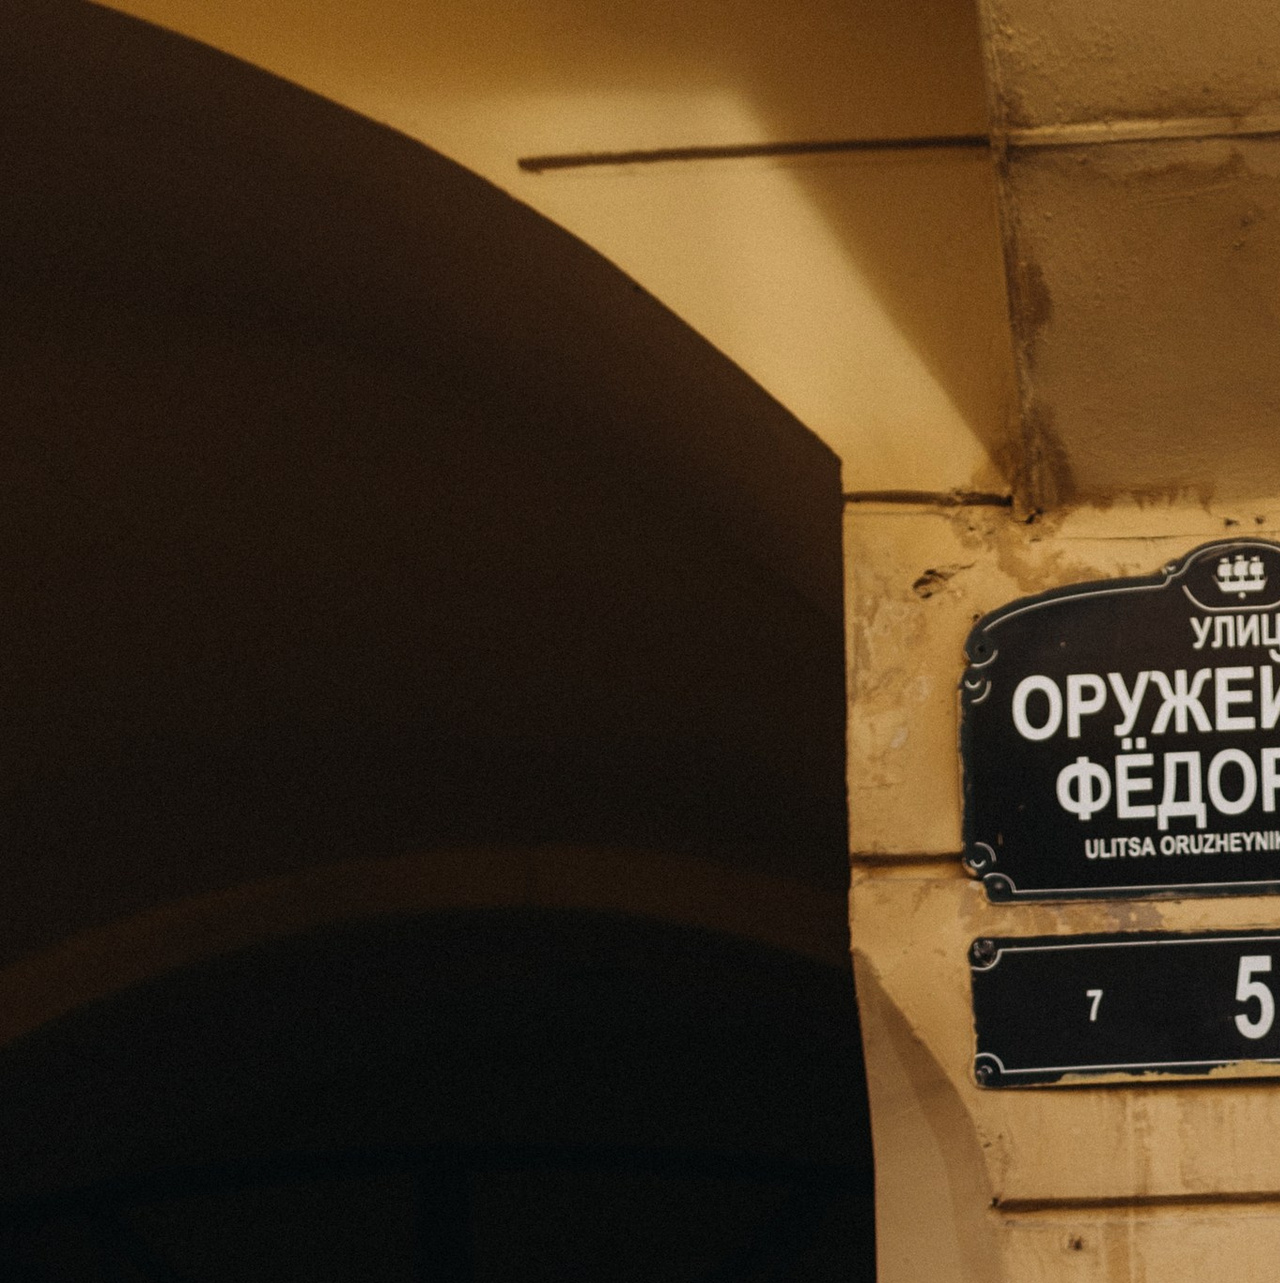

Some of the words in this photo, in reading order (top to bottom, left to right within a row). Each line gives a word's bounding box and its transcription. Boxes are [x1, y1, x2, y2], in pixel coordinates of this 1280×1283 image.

[1084, 835, 1157, 860] ULITSA
[1086, 989, 1103, 1022] 7
[1234, 955, 1275, 1040] 5
